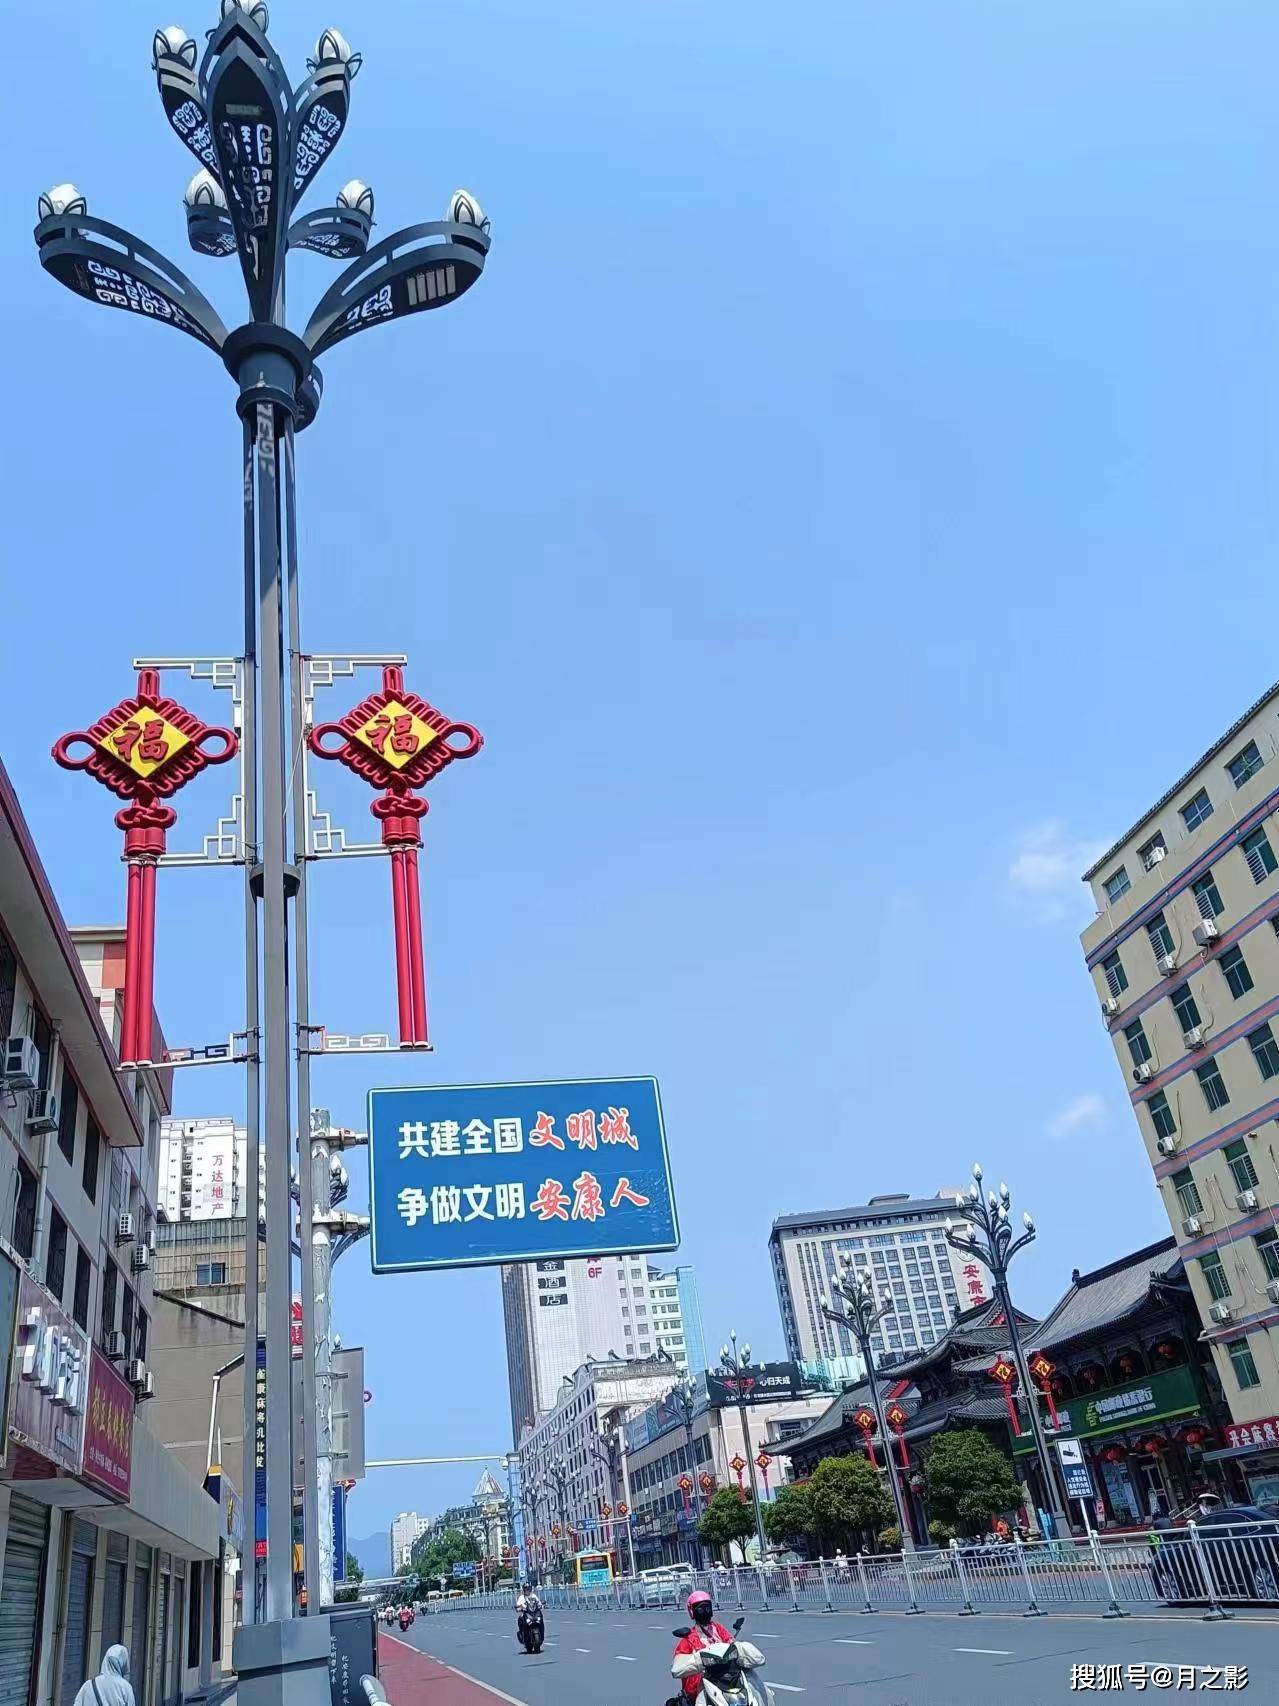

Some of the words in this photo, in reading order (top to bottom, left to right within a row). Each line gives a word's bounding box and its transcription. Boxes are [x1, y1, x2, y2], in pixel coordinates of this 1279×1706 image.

[112, 718, 168, 763] 福
[365, 713, 420, 757] 福
[397, 1106, 639, 1160] 共建全国文明城
[211, 1154, 225, 1216] 万达地产
[397, 1171, 650, 1227] 争做文明安康人
